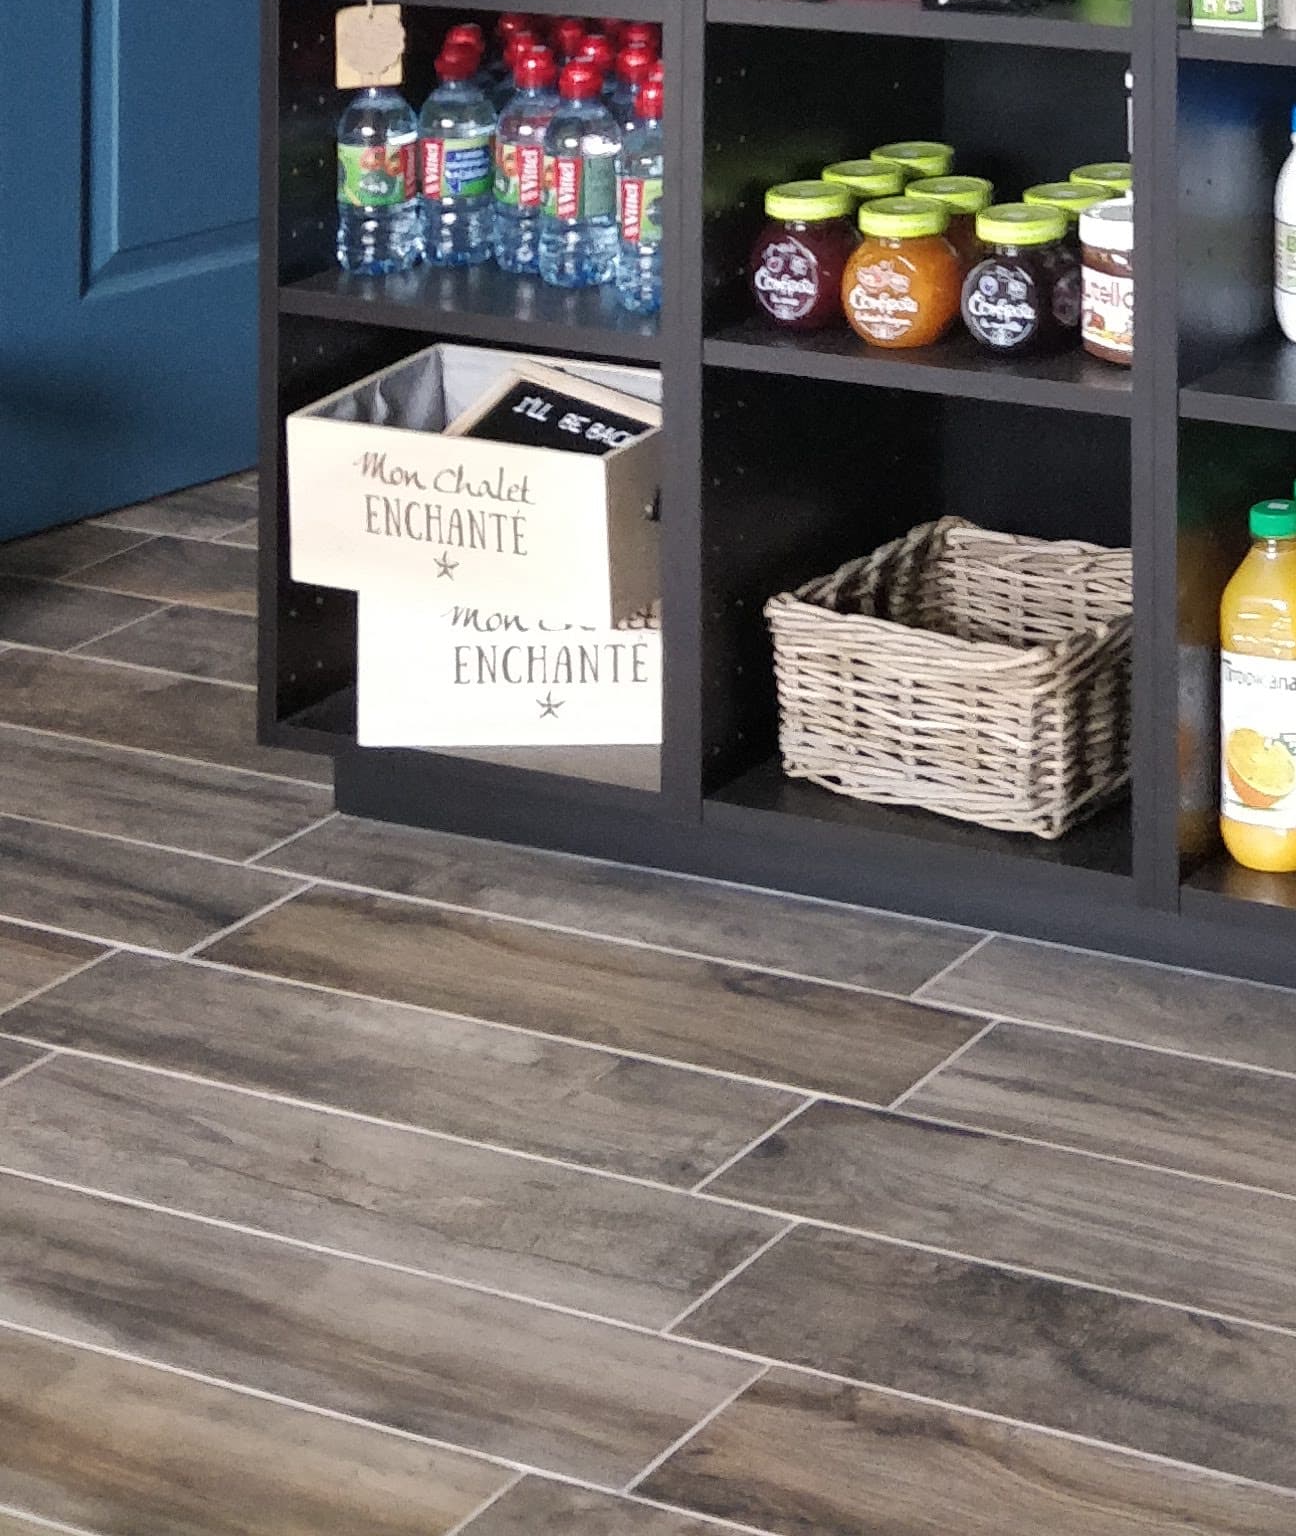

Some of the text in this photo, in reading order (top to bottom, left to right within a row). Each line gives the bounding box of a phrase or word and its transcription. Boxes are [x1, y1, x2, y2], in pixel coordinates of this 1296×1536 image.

[352, 451, 536, 505] Mon Chalet
[365, 493, 529, 557] ENCHANTÉ
[454, 633, 648, 685] ENCHANTÉ
